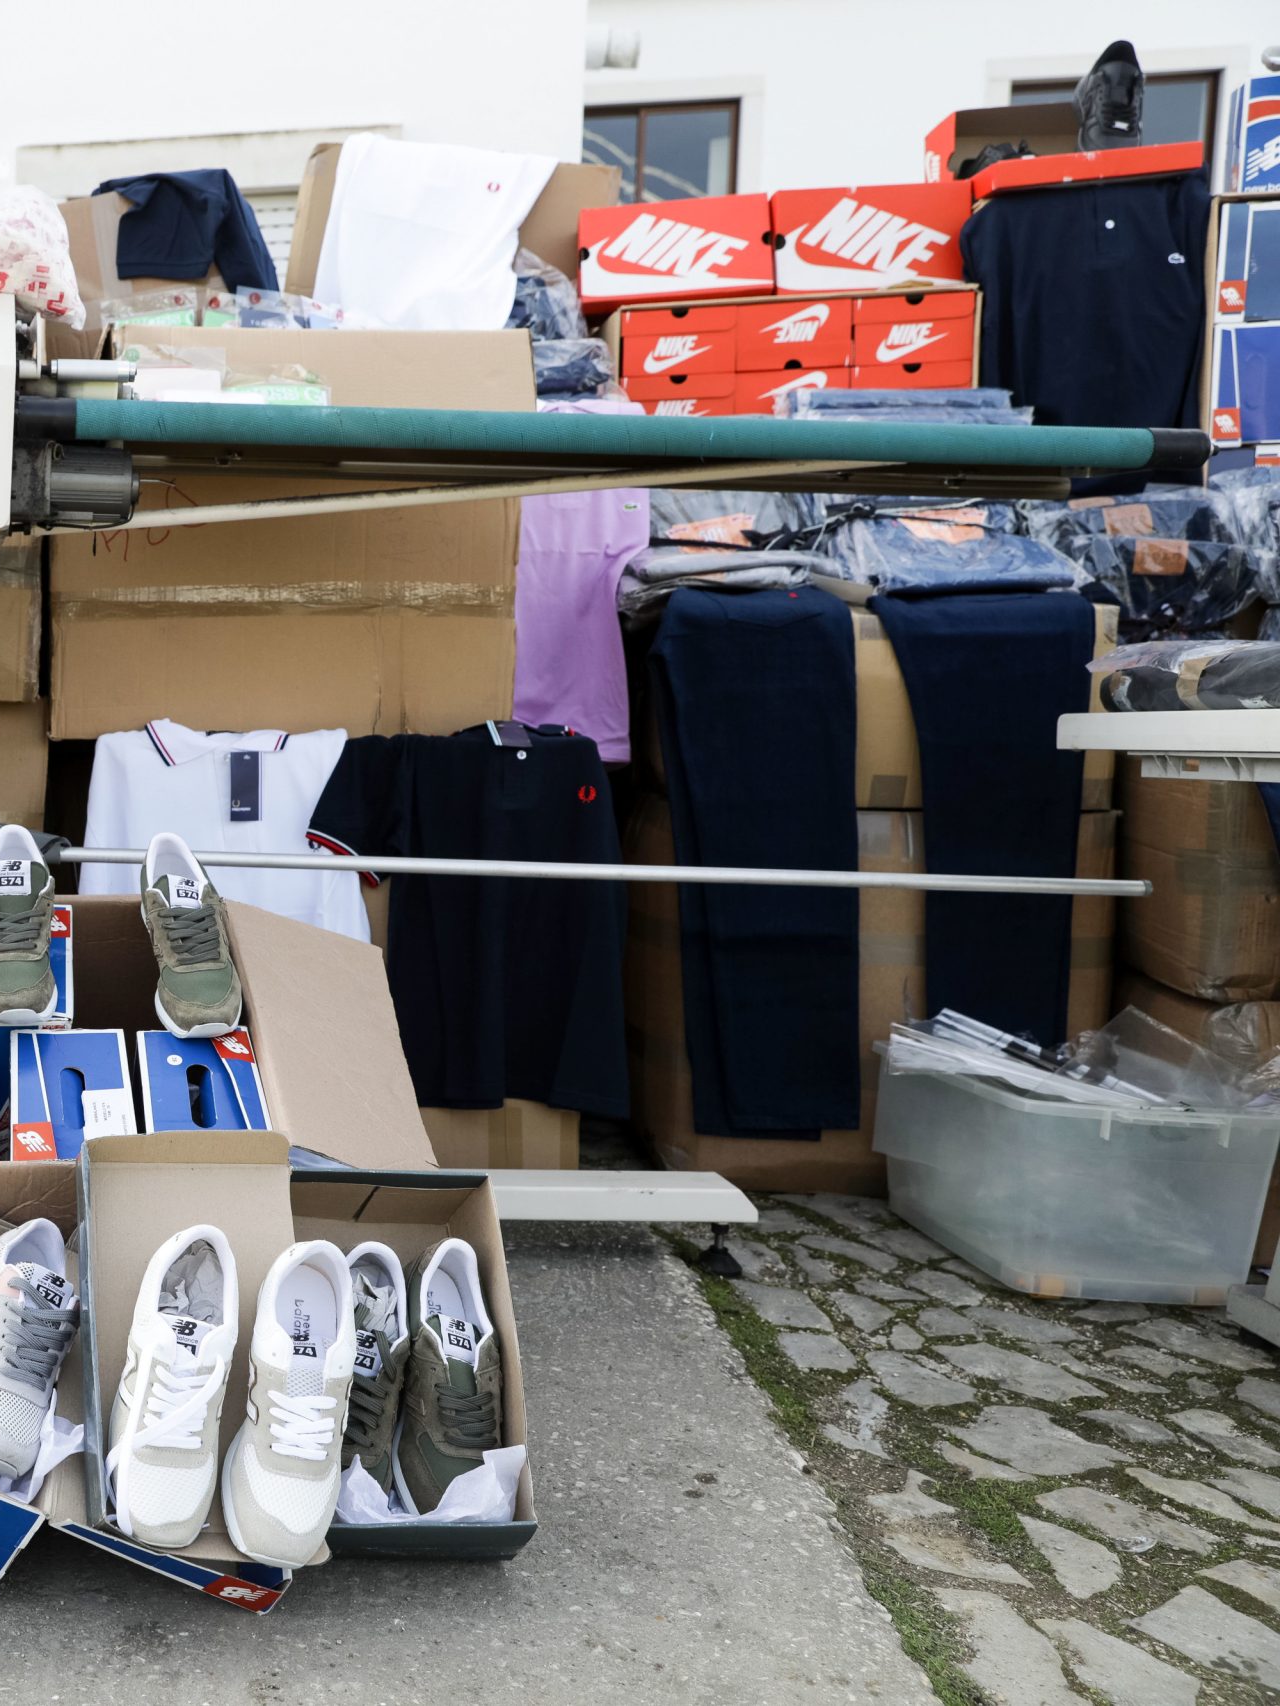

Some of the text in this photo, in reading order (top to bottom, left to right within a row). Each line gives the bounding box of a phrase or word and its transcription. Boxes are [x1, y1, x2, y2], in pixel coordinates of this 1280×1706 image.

[603, 212, 750, 279] NIKE
[801, 197, 951, 279] NIKE
[773, 320, 820, 344] NIKE
[886, 322, 934, 346] NIKE
[653, 335, 699, 358] NIKE
[654, 399, 698, 416] NIKE
[0, 877, 22, 885] 574
[178, 889, 199, 899] 574
[39, 1286, 61, 1305] 574
[47, 1283, 66, 1295] balance
[293, 1346, 314, 1355] 74
[450, 1335, 471, 1350] 574
[355, 1355, 371, 1367] 74
